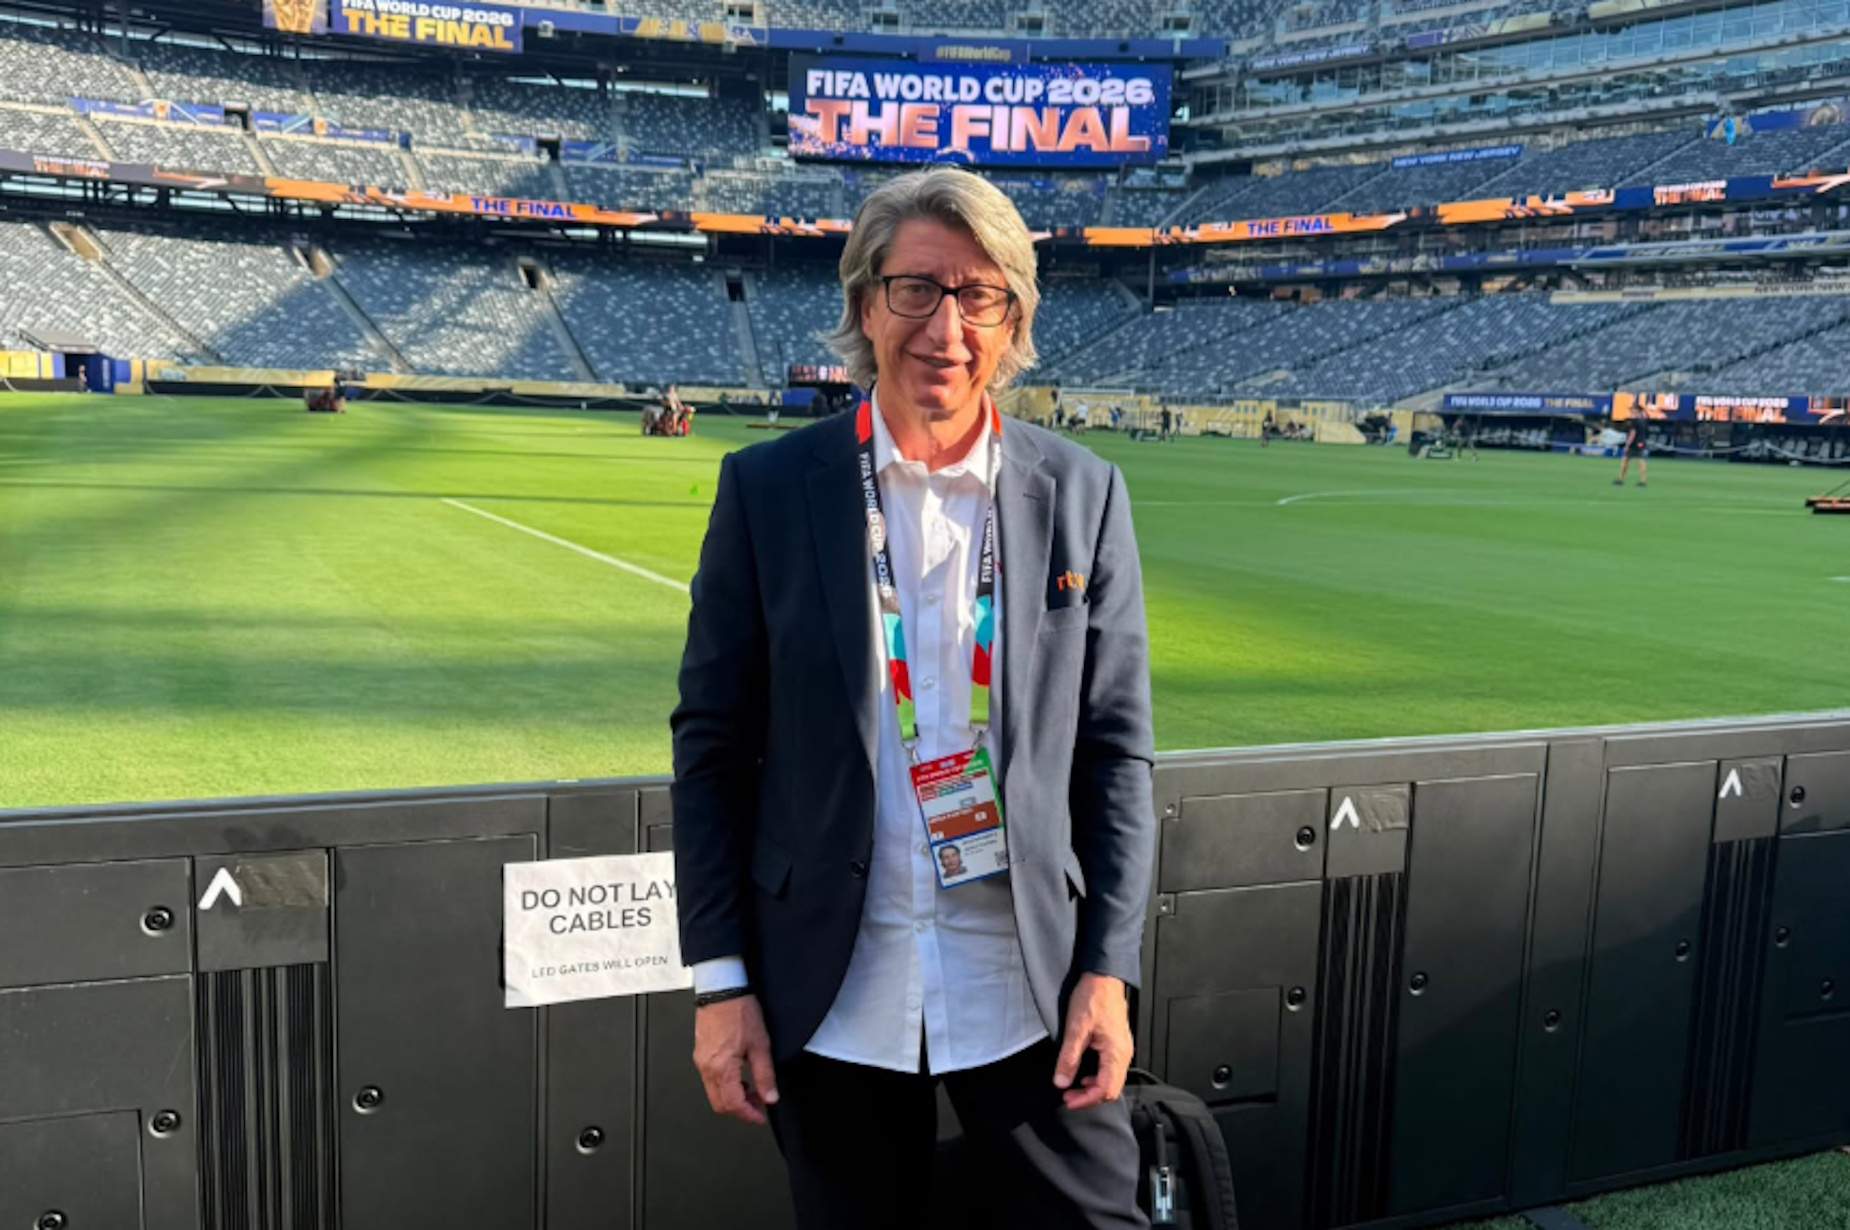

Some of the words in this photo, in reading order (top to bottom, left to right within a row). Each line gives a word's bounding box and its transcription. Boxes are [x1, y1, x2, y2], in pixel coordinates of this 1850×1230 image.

[373, 0, 430, 17] WORLD
[431, 5, 462, 20] CUP
[462, 8, 515, 27] 2026
[342, 8, 411, 38] THE
[416, 16, 514, 49] FINAL
[806, 69, 871, 99] FIFA
[874, 74, 981, 102] WORLD
[984, 76, 1045, 103] CUP
[1047, 77, 1154, 105] 2026
[804, 98, 940, 148] THE
[951, 103, 1151, 153] FINAL
[471, 198, 511, 215] THE
[516, 201, 576, 220] FINAL
[1248, 221, 1280, 237] THE
[1283, 217, 1335, 233] FINAL
[858, 451, 873, 479] FIFA
[862, 478, 882, 524] WORLD
[981, 555, 992, 584] FIFA
[521, 888, 561, 911] DO
[568, 883, 624, 907] NOT
[631, 880, 675, 902] LAY
[549, 907, 652, 935] CABLES
[532, 966, 557, 979] LED
[559, 960, 600, 976] GATES
[602, 957, 632, 971] WILL
[634, 955, 668, 969] OPEN
